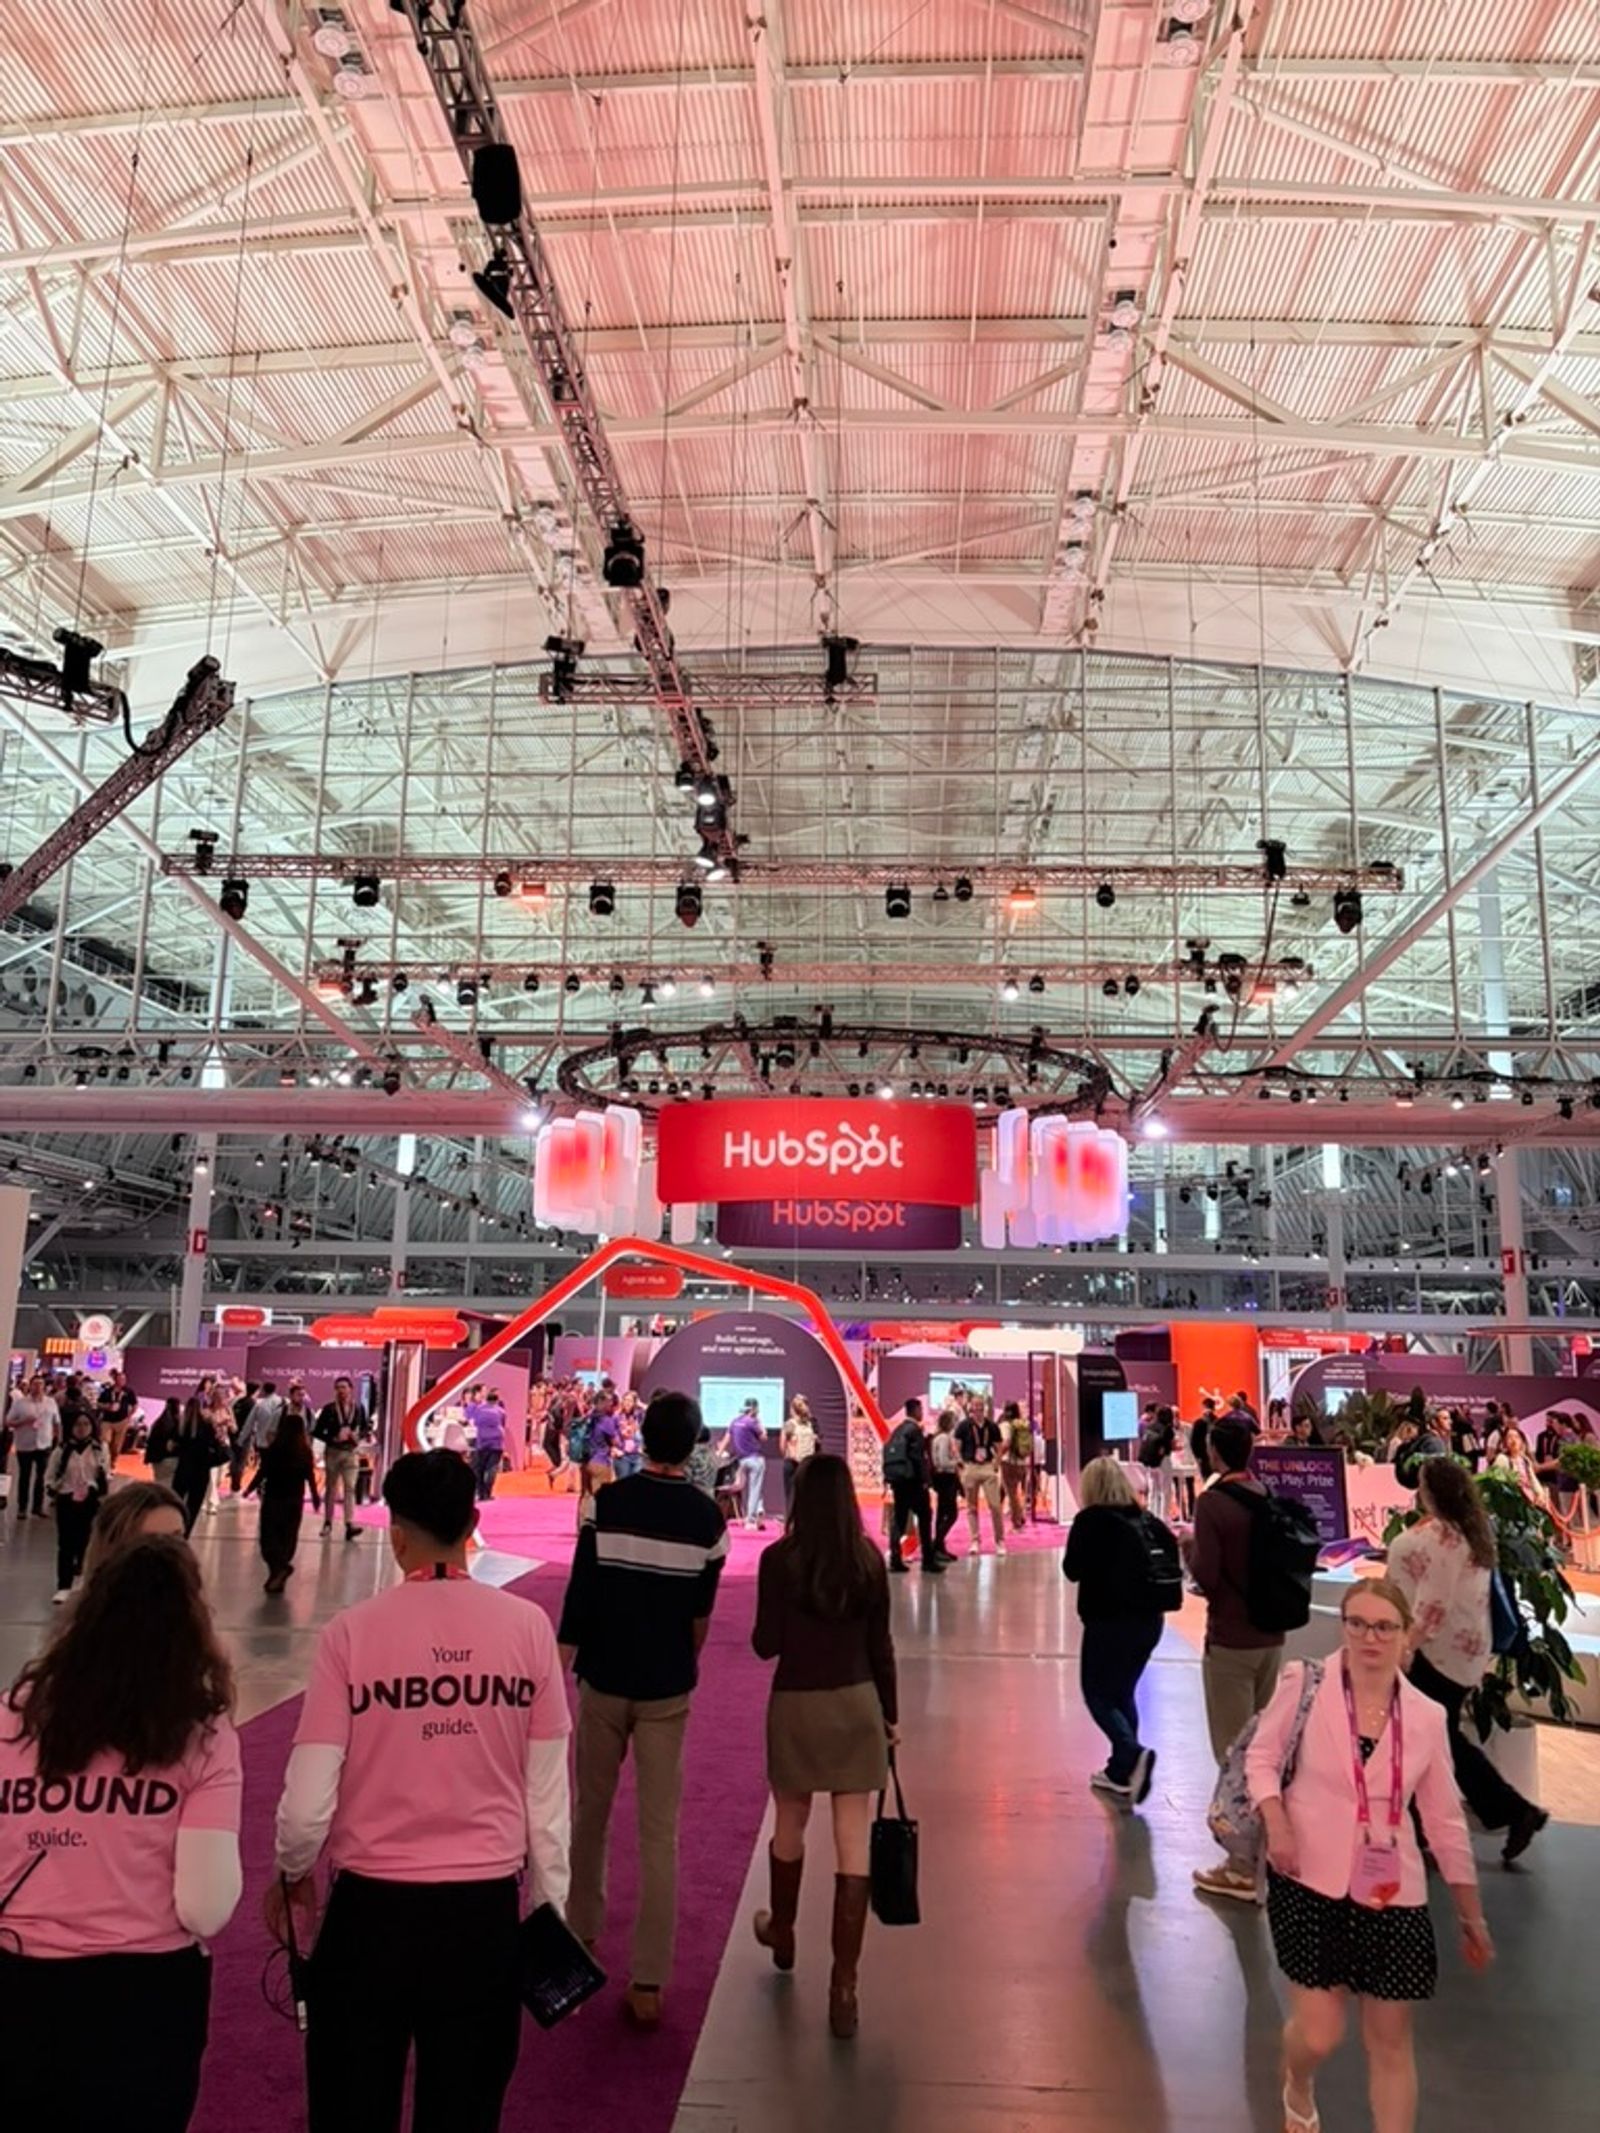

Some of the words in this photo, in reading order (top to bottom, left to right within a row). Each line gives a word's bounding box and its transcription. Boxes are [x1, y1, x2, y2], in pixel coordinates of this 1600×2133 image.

[724, 1121, 904, 1175] HubSpot
[773, 1201, 906, 1232] HubSpot
[324, 1325, 363, 1335] Customer
[366, 1326, 398, 1337] Support
[428, 1327, 454, 1336] Center
[701, 1345, 717, 1353] and
[1257, 1459, 1280, 1472] THE
[1283, 1460, 1334, 1473] UNLOCK
[1307, 1474, 1334, 1487] Prize
[431, 1647, 473, 1664] Your
[348, 1674, 535, 1716] UNBOUND
[422, 1718, 478, 1740] guide.
[0, 1776, 178, 1815] BOUND
[27, 1827, 88, 1849] guide.
